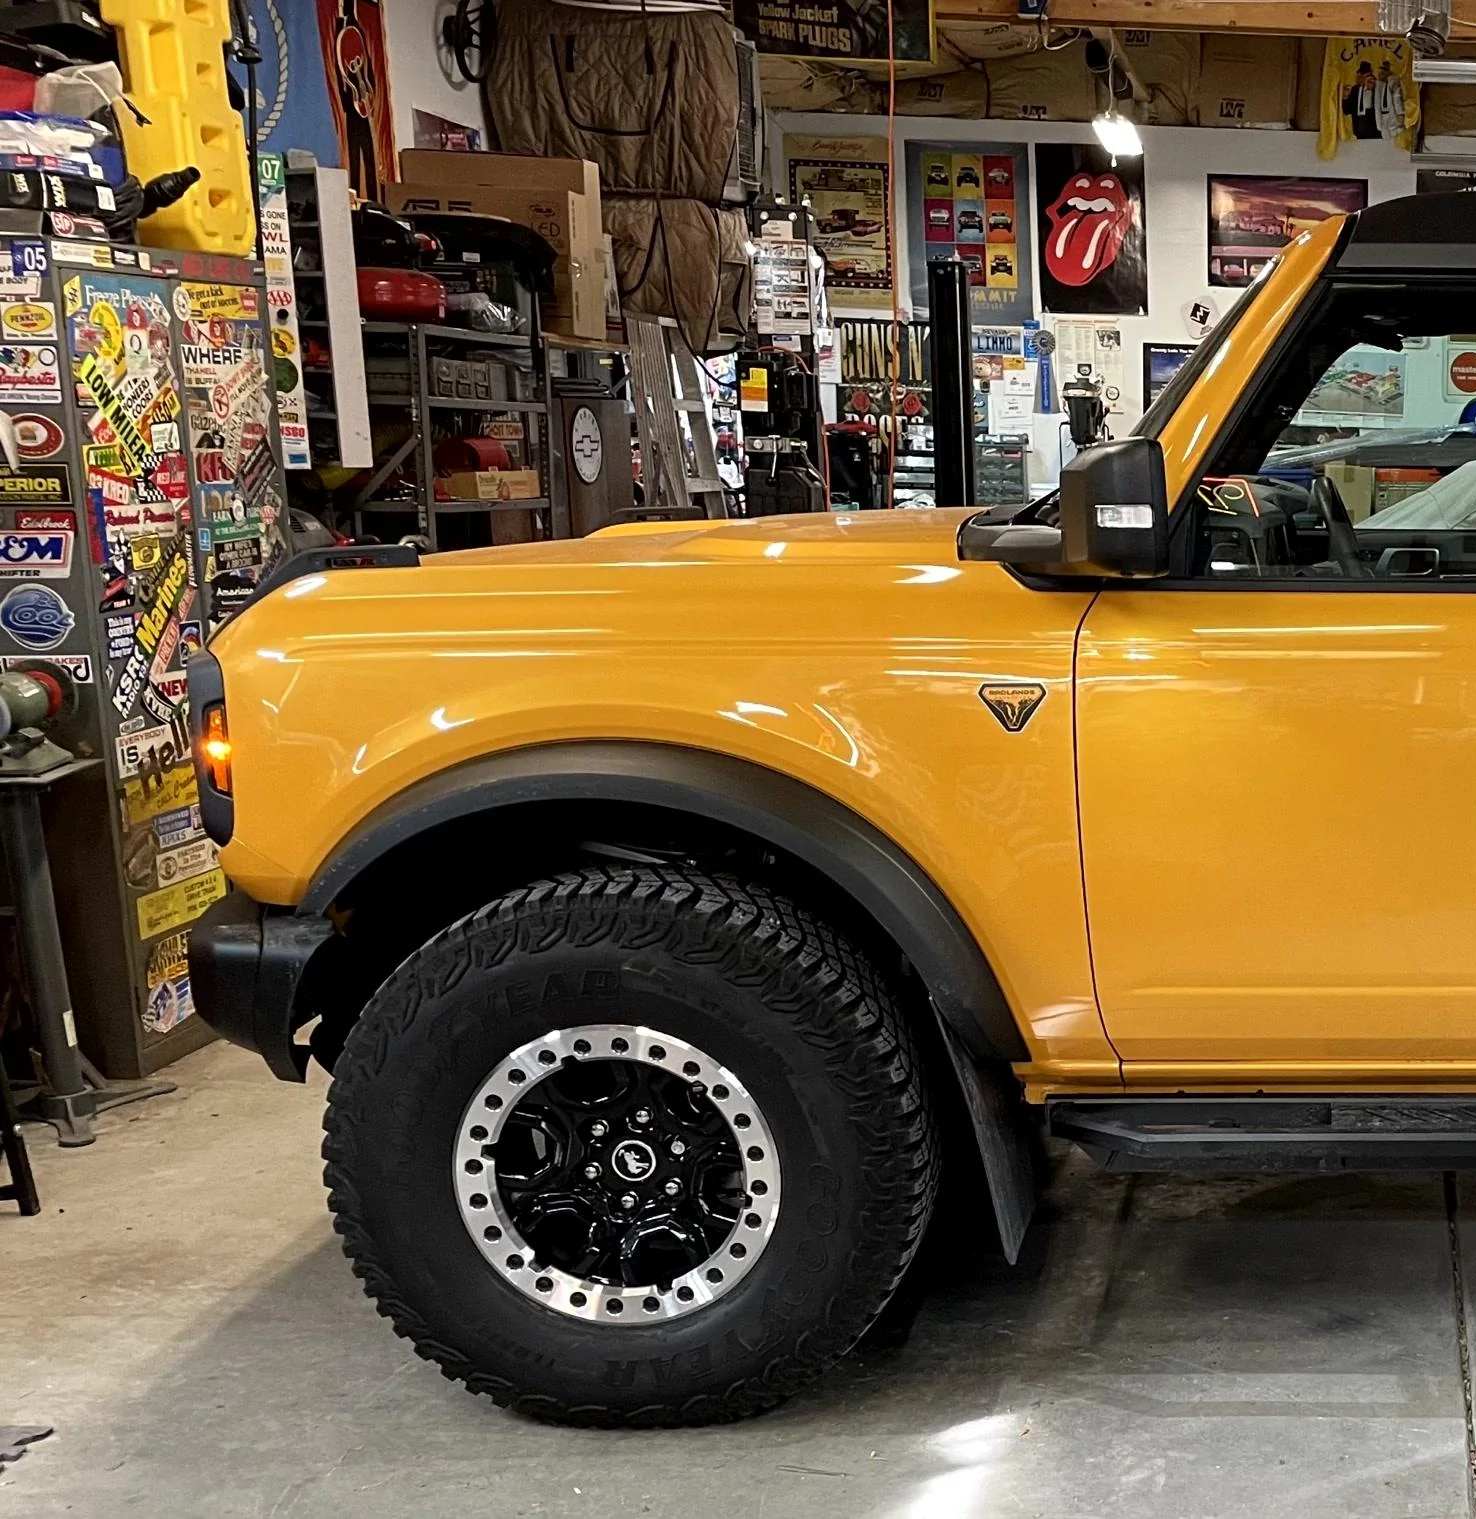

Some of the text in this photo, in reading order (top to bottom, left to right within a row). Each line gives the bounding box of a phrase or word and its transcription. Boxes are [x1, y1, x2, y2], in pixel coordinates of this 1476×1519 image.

[758, 4, 839, 24] Yellow Jacket
[758, 19, 851, 52] SPARK PLUGS
[262, 160, 281, 179] 07
[267, 210, 286, 220] GONE
[23, 247, 47, 271] 05
[10, 313, 46, 323] PENNZOIL
[182, 347, 242, 365] WHERE
[85, 364, 115, 409] LOW
[136, 552, 187, 655] Marines
[121, 680, 141, 719] RADIO
[119, 727, 166, 747] EVERYBODY
[121, 745, 139, 766] IS
